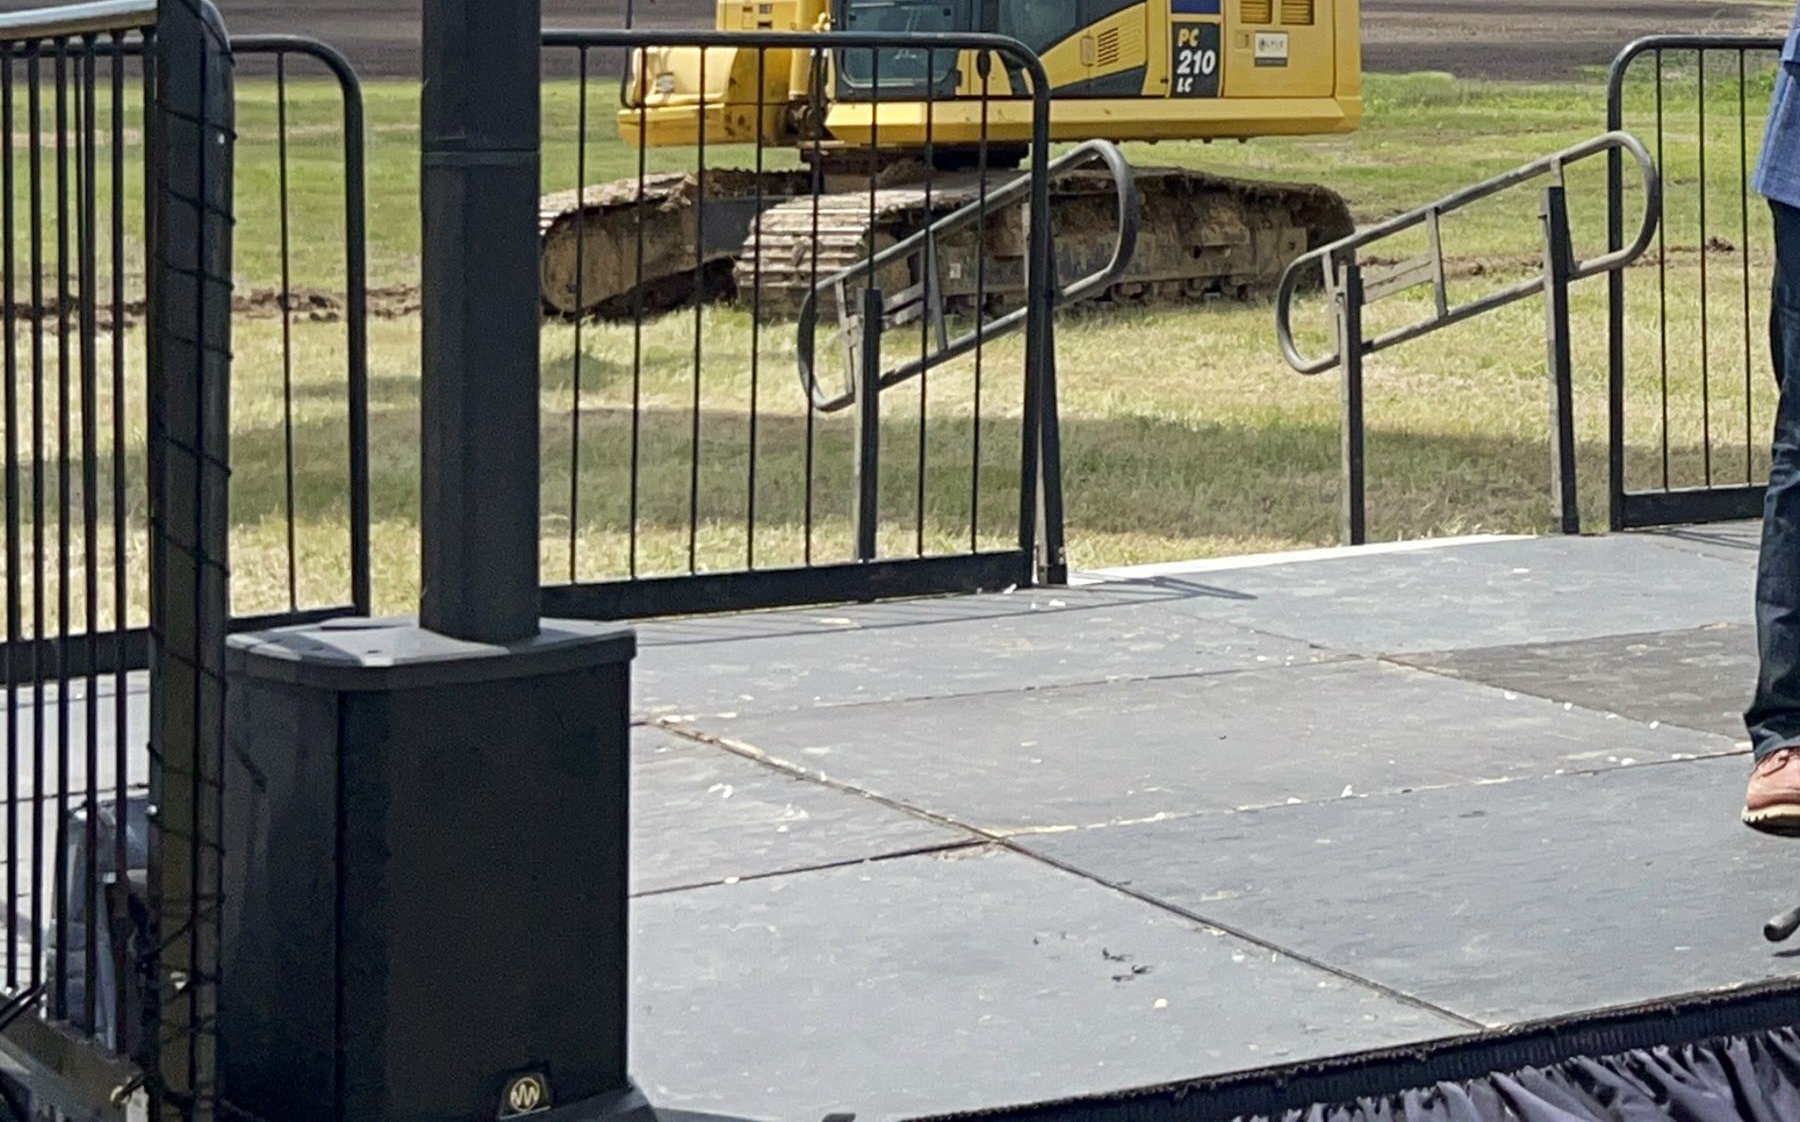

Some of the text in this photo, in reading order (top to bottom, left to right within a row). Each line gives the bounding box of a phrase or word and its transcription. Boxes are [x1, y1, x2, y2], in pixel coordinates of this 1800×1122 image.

[1178, 28, 1199, 47] PC
[1176, 49, 1216, 75] 210
[1176, 77, 1193, 93] LC
